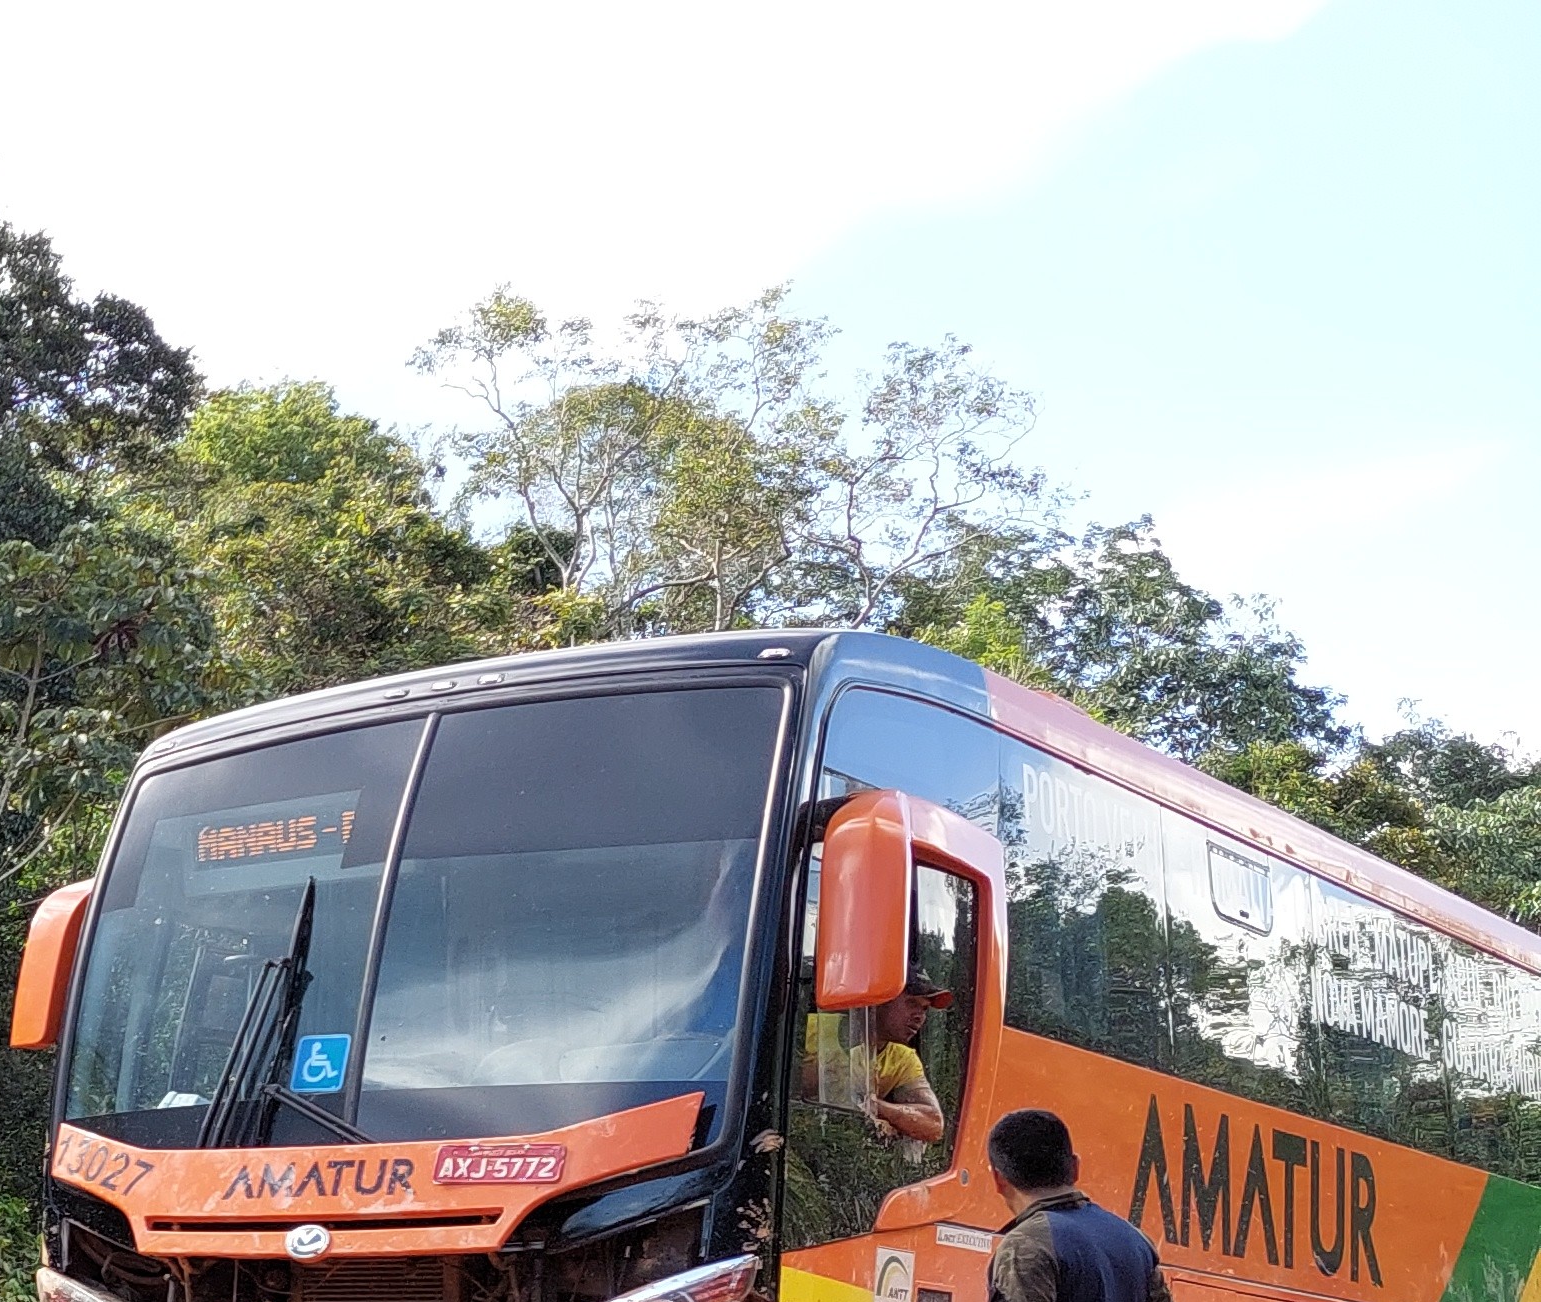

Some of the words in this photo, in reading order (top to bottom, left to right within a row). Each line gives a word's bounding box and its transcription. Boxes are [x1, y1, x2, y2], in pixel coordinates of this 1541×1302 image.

[1022, 763, 1097, 849] PORTO
[198, 816, 317, 862] MANAUS
[58, 1133, 155, 1197] 13027
[221, 1157, 416, 1200] AMATUR
[438, 1156, 558, 1179] AXJ-5772
[1128, 1093, 1384, 1288] AMATUR
